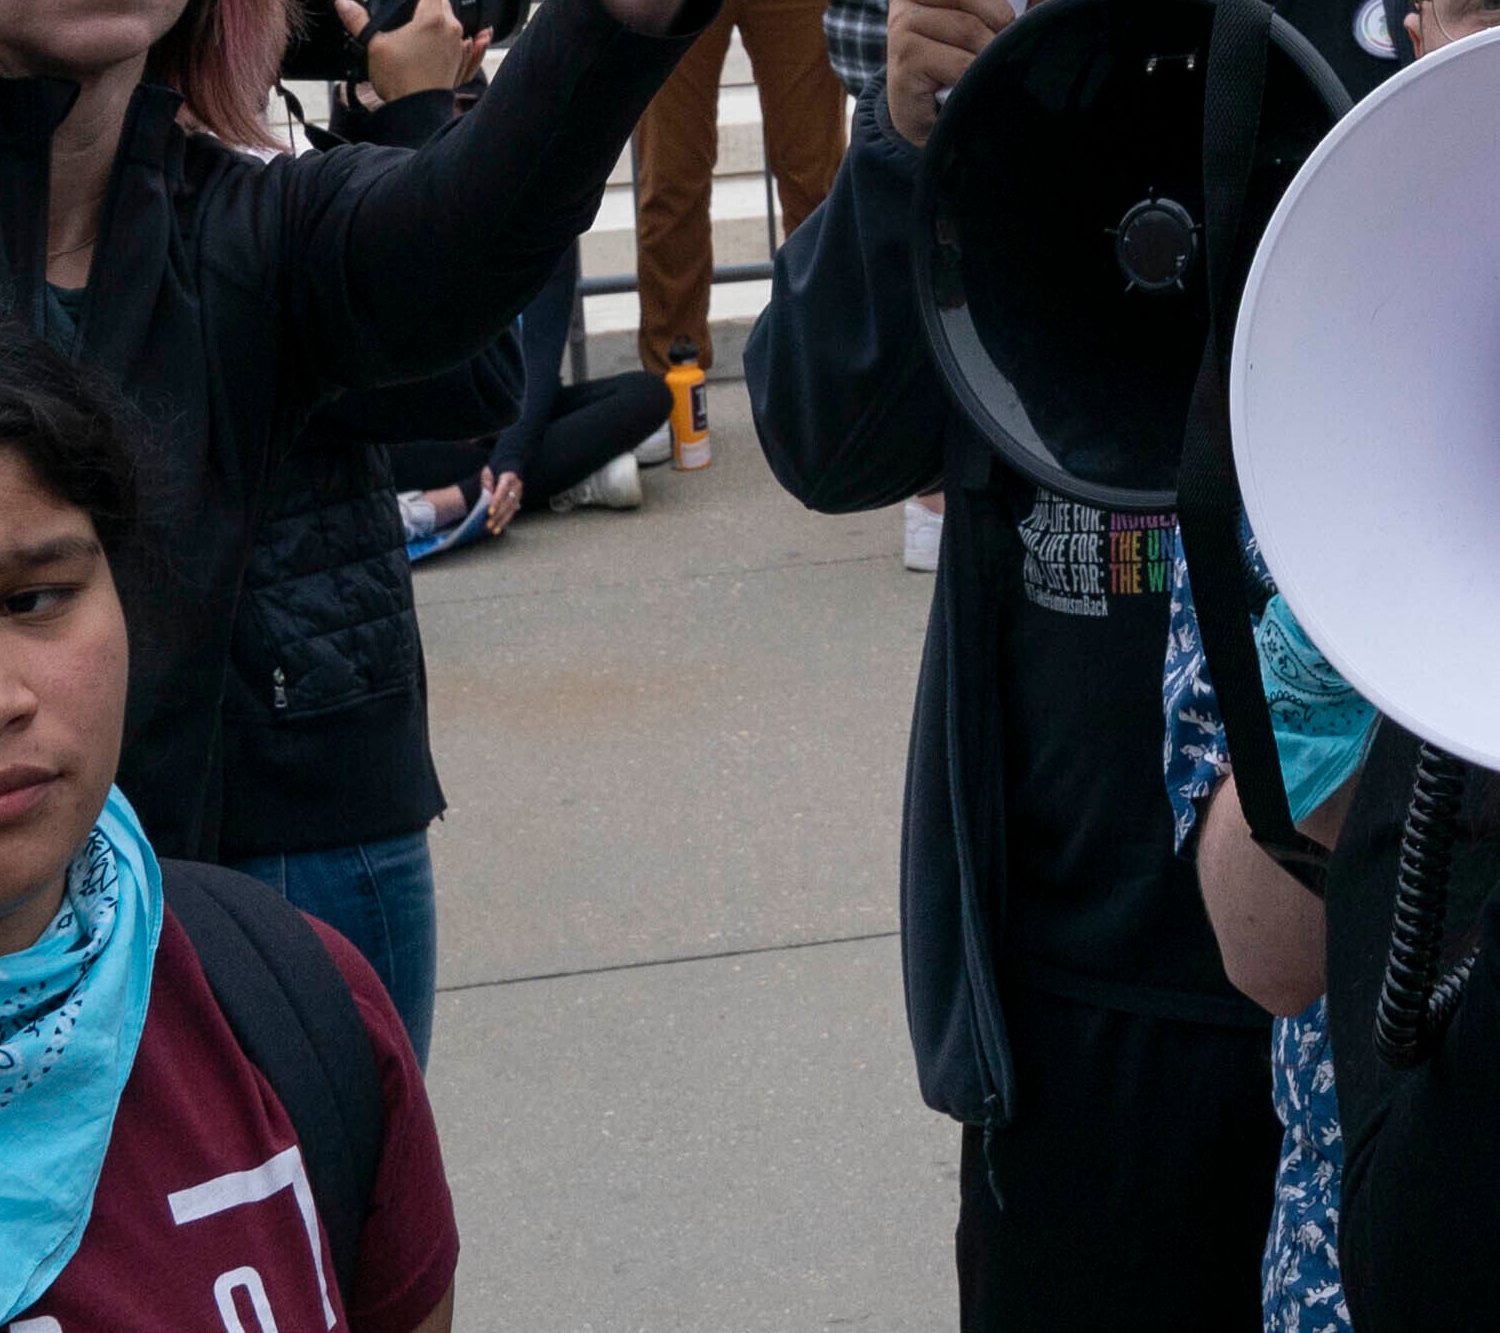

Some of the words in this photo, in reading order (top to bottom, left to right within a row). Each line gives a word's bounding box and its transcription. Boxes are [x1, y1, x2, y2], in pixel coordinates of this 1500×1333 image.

[1070, 533, 1104, 564] FOR:
[1109, 531, 1143, 563] THE
[1070, 563, 1105, 594] FOR:
[1109, 562, 1143, 594] THE
